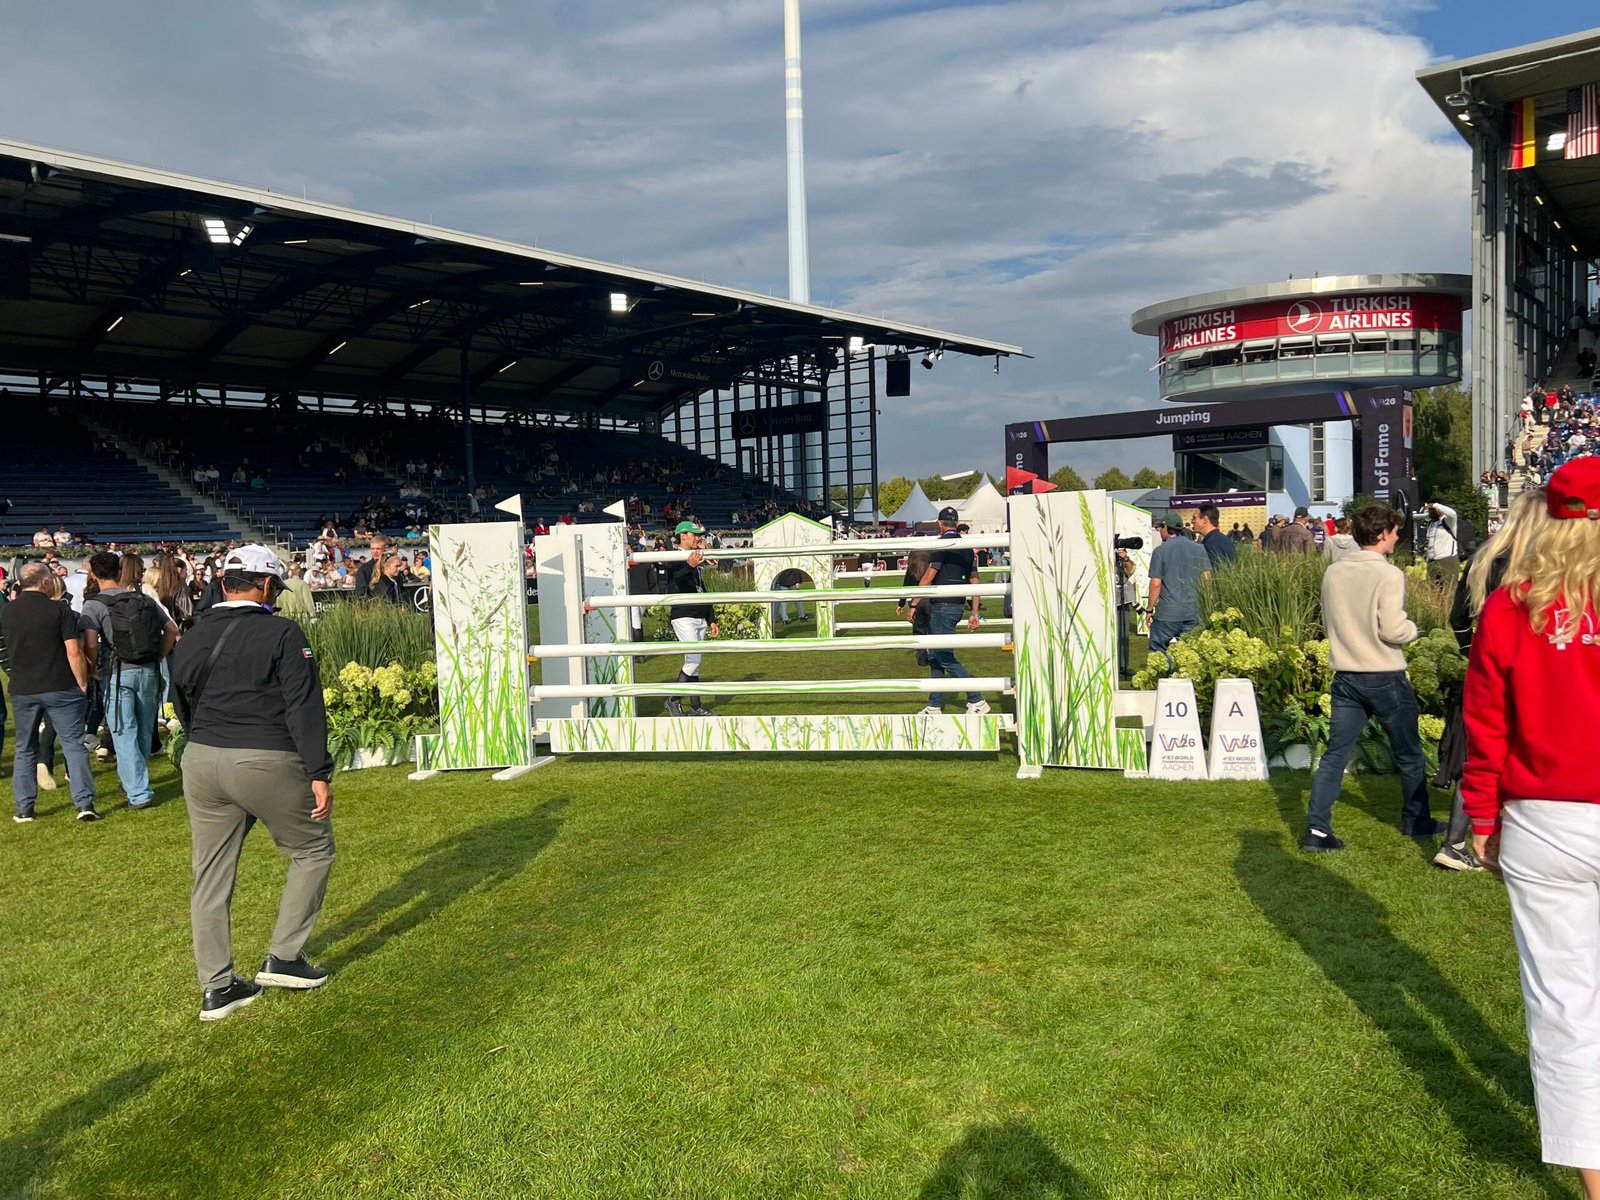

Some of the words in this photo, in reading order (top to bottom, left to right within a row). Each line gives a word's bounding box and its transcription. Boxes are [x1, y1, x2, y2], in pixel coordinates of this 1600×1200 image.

[1329, 296, 1411, 313] TURKISH
[1173, 309, 1235, 333] TURKISH
[1329, 312, 1412, 330] AIRLINES
[1173, 325, 1236, 350] AIRLINES
[1155, 410, 1211, 425] Jumping
[1374, 423, 1390, 467] Fame
[1374, 469, 1390, 486] of
[1164, 702, 1188, 718] 10
[1228, 701, 1244, 717] A
[1162, 763, 1194, 771] AACHEN
